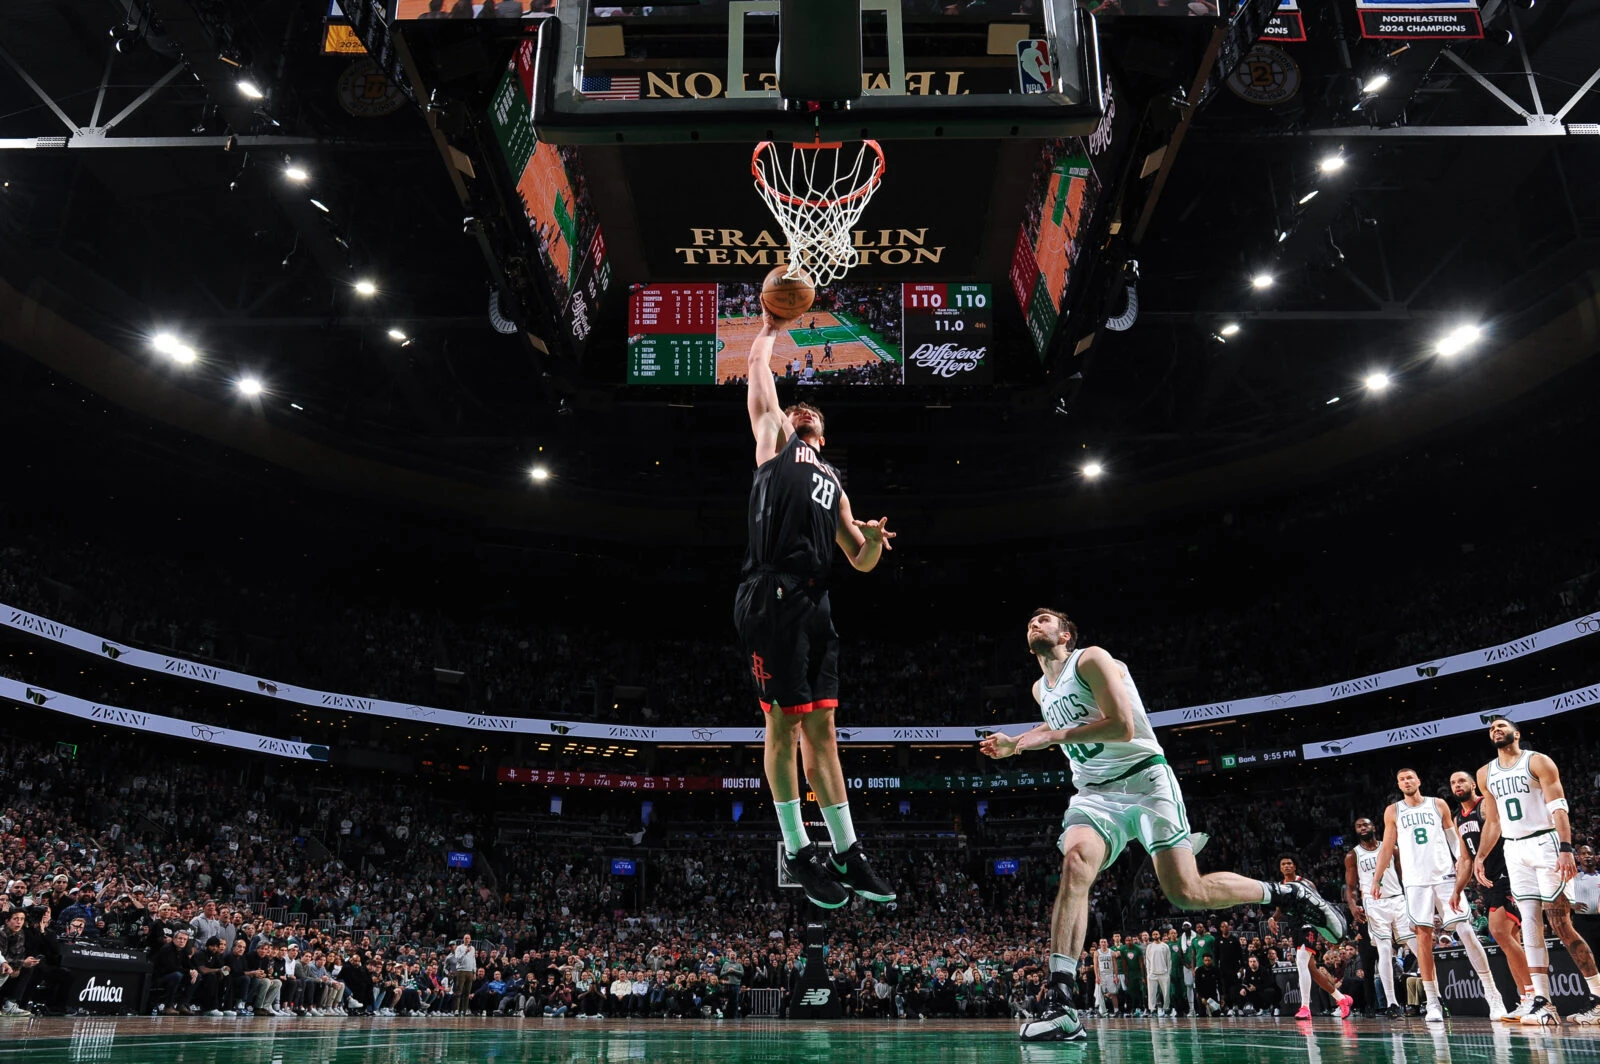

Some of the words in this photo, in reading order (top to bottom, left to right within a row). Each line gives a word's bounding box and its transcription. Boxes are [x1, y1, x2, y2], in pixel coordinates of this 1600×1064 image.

[1253, 66, 1269, 81] 2
[1026, 84, 1041, 93] NBA
[911, 294, 942, 307] 110
[956, 294, 986, 307] 110
[935, 320, 964, 331] 11.0
[909, 343, 987, 364] Different
[932, 359, 977, 378] Here
[811, 473, 835, 510] 28
[10, 611, 67, 639] ZENNI
[1485, 636, 1539, 662] ZENNI
[164, 659, 220, 681] ZENNI
[1331, 676, 1380, 697] ZENNI
[322, 694, 375, 712] ZENNI
[1553, 690, 1600, 710] ZENN
[91, 705, 150, 727] ZENNI
[1182, 704, 1233, 720] ZENNI
[467, 716, 518, 729] ZENNI
[609, 727, 657, 739] ZENNI
[893, 728, 942, 738] ZENNI
[1387, 723, 1440, 743] ZENNI
[258, 738, 307, 756] ZENNI
[1223, 757, 1235, 766] TD
[1238, 755, 1256, 763] Bank
[1263, 752, 1281, 760] 9:55
[1283, 750, 1296, 758] PM
[619, 780, 637, 788] 39/90
[722, 778, 760, 788] HOUSTON
[847, 778, 863, 788] 10
[868, 778, 900, 788] BOSTON
[1490, 776, 1530, 799] CELTICS
[1505, 797, 1523, 821] 0
[1401, 812, 1435, 829] CELTICS
[1414, 827, 1428, 845] 8
[1466, 837, 1476, 855] 9
[1360, 856, 1377, 872] CELT
[79, 976, 123, 1003] Amica
